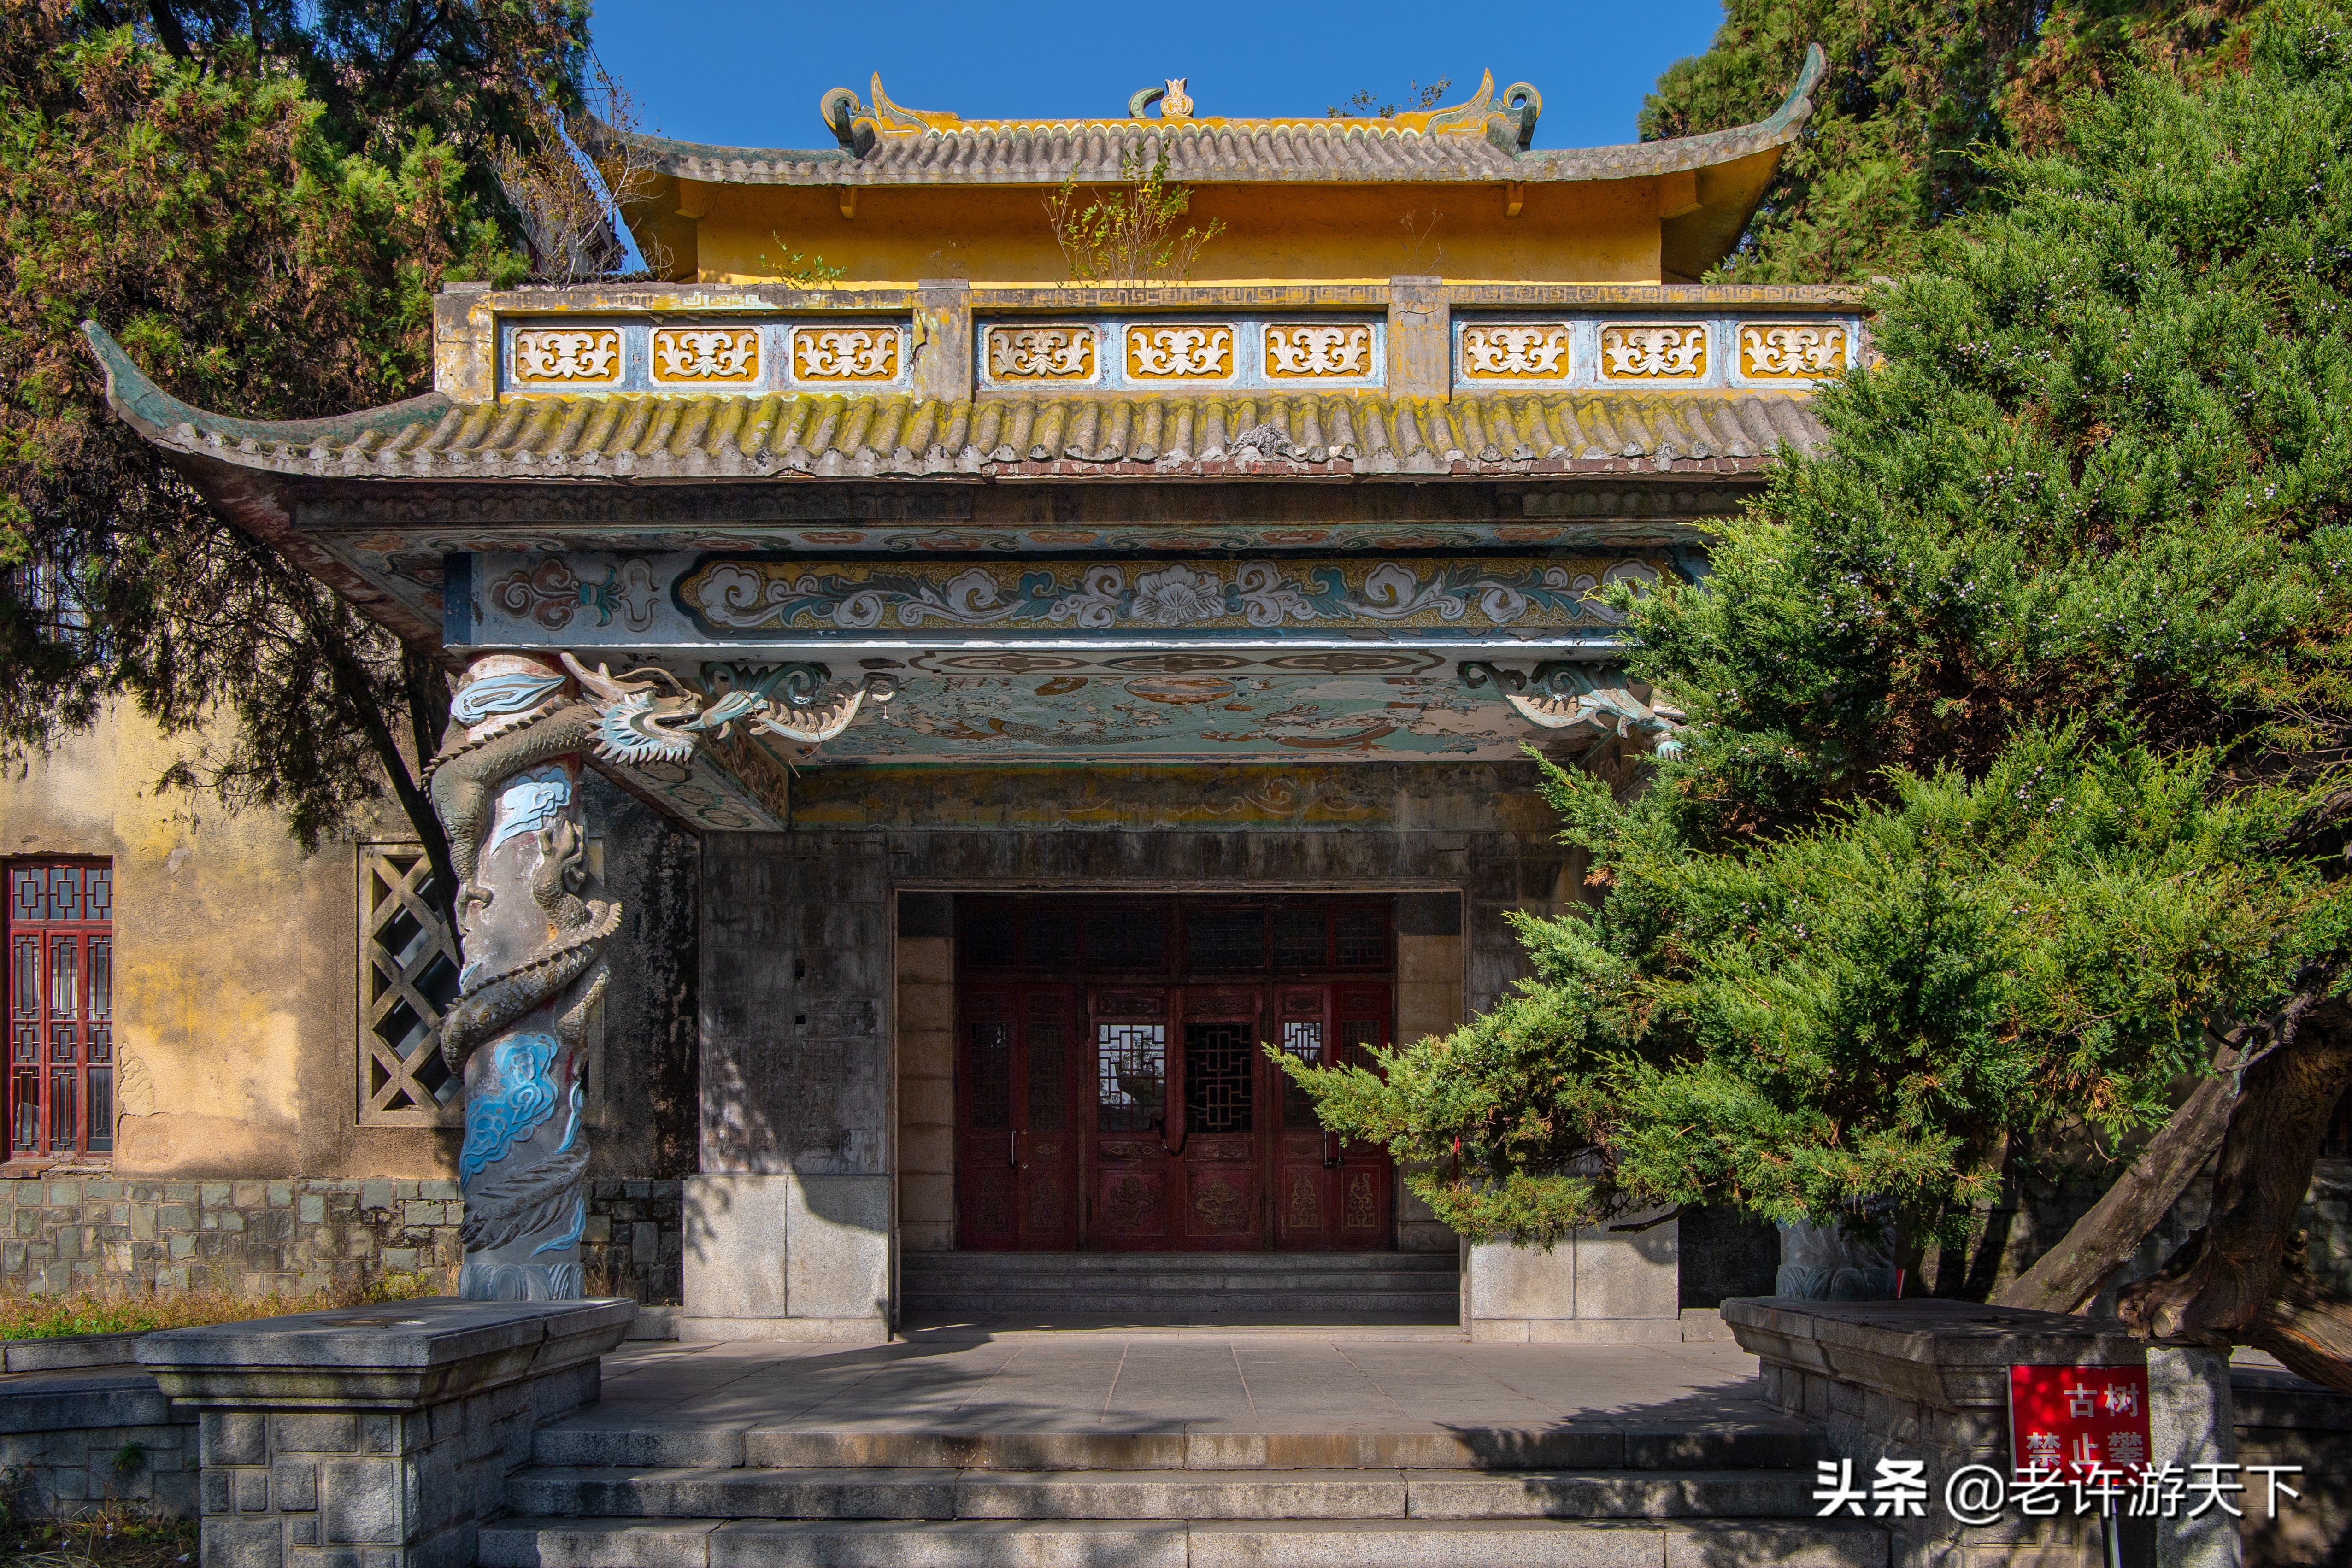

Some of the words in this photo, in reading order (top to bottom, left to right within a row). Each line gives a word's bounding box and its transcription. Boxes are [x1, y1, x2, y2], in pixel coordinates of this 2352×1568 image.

[2064, 1383, 2139, 1418] 古树
[2026, 1432, 2143, 1467] 禁止攀
